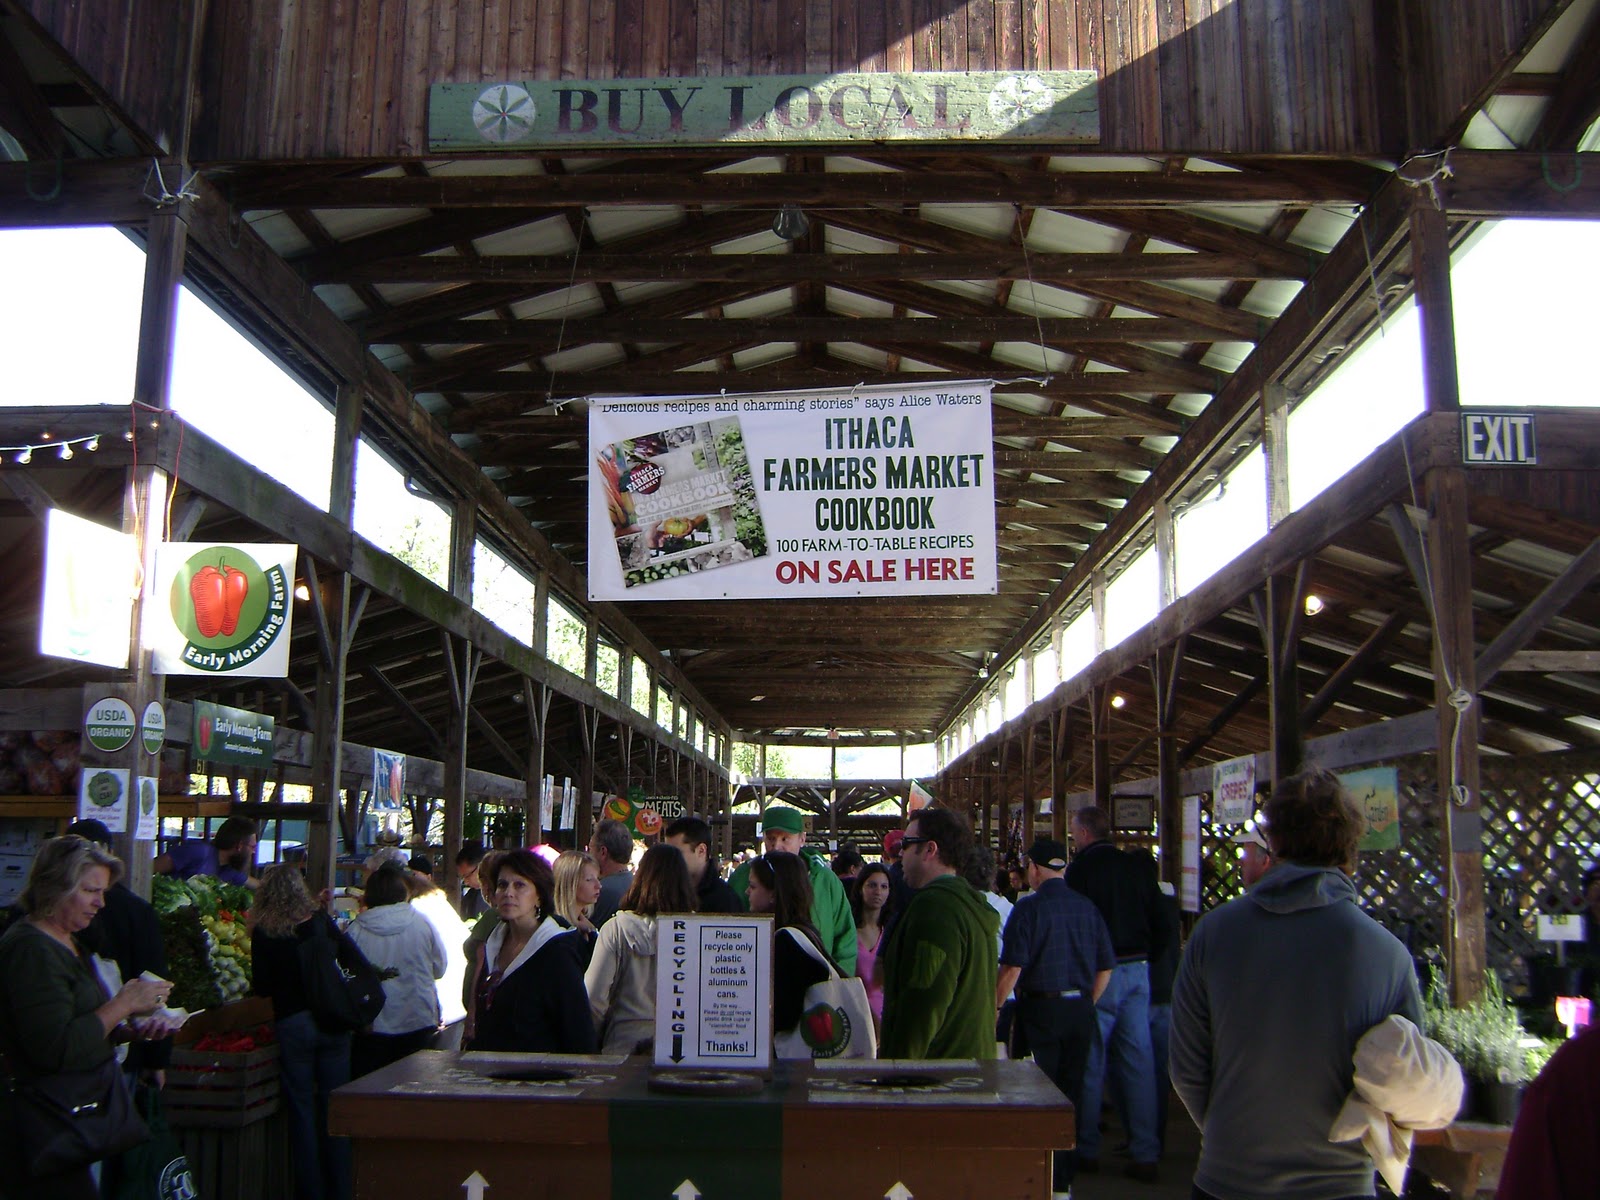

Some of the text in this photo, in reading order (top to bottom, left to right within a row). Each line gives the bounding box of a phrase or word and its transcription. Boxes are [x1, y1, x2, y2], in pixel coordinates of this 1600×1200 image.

[553, 83, 973, 134] BUY LOCAL
[664, 400, 710, 414] recipes
[714, 399, 739, 412] and
[743, 398, 805, 413] charming
[865, 398, 894, 411] says
[899, 395, 931, 407] Alice
[935, 393, 981, 405] Waters
[825, 416, 914, 450] ITHACA
[1466, 416, 1529, 461] EXIT
[626, 466, 665, 493] FARMERS
[629, 465, 654, 481] ITHACA
[764, 454, 984, 492] FARMERS MARKET
[634, 482, 731, 516] COOKBOOK
[815, 496, 935, 531] COOKBOOK
[776, 535, 974, 553] 100 FARM-TO-TABLE RECIPES
[775, 557, 975, 584] ON SALE HERE
[185, 570, 285, 670] Early Morning Farm
[96, 709, 127, 721] USDA
[90, 727, 131, 738] ORGANIC
[215, 717, 272, 743] Early Morning Farm
[644, 801, 681, 818] MEATS
[715, 930, 742, 939] Please
[704, 942, 753, 952] recycle only
[715, 954, 742, 963] plastic
[671, 920, 687, 1032] RECYCLING
[710, 966, 746, 975] bottles &
[708, 978, 748, 987] aluminum
[717, 990, 739, 999] cans.
[706, 1040, 749, 1052] Thanks!
